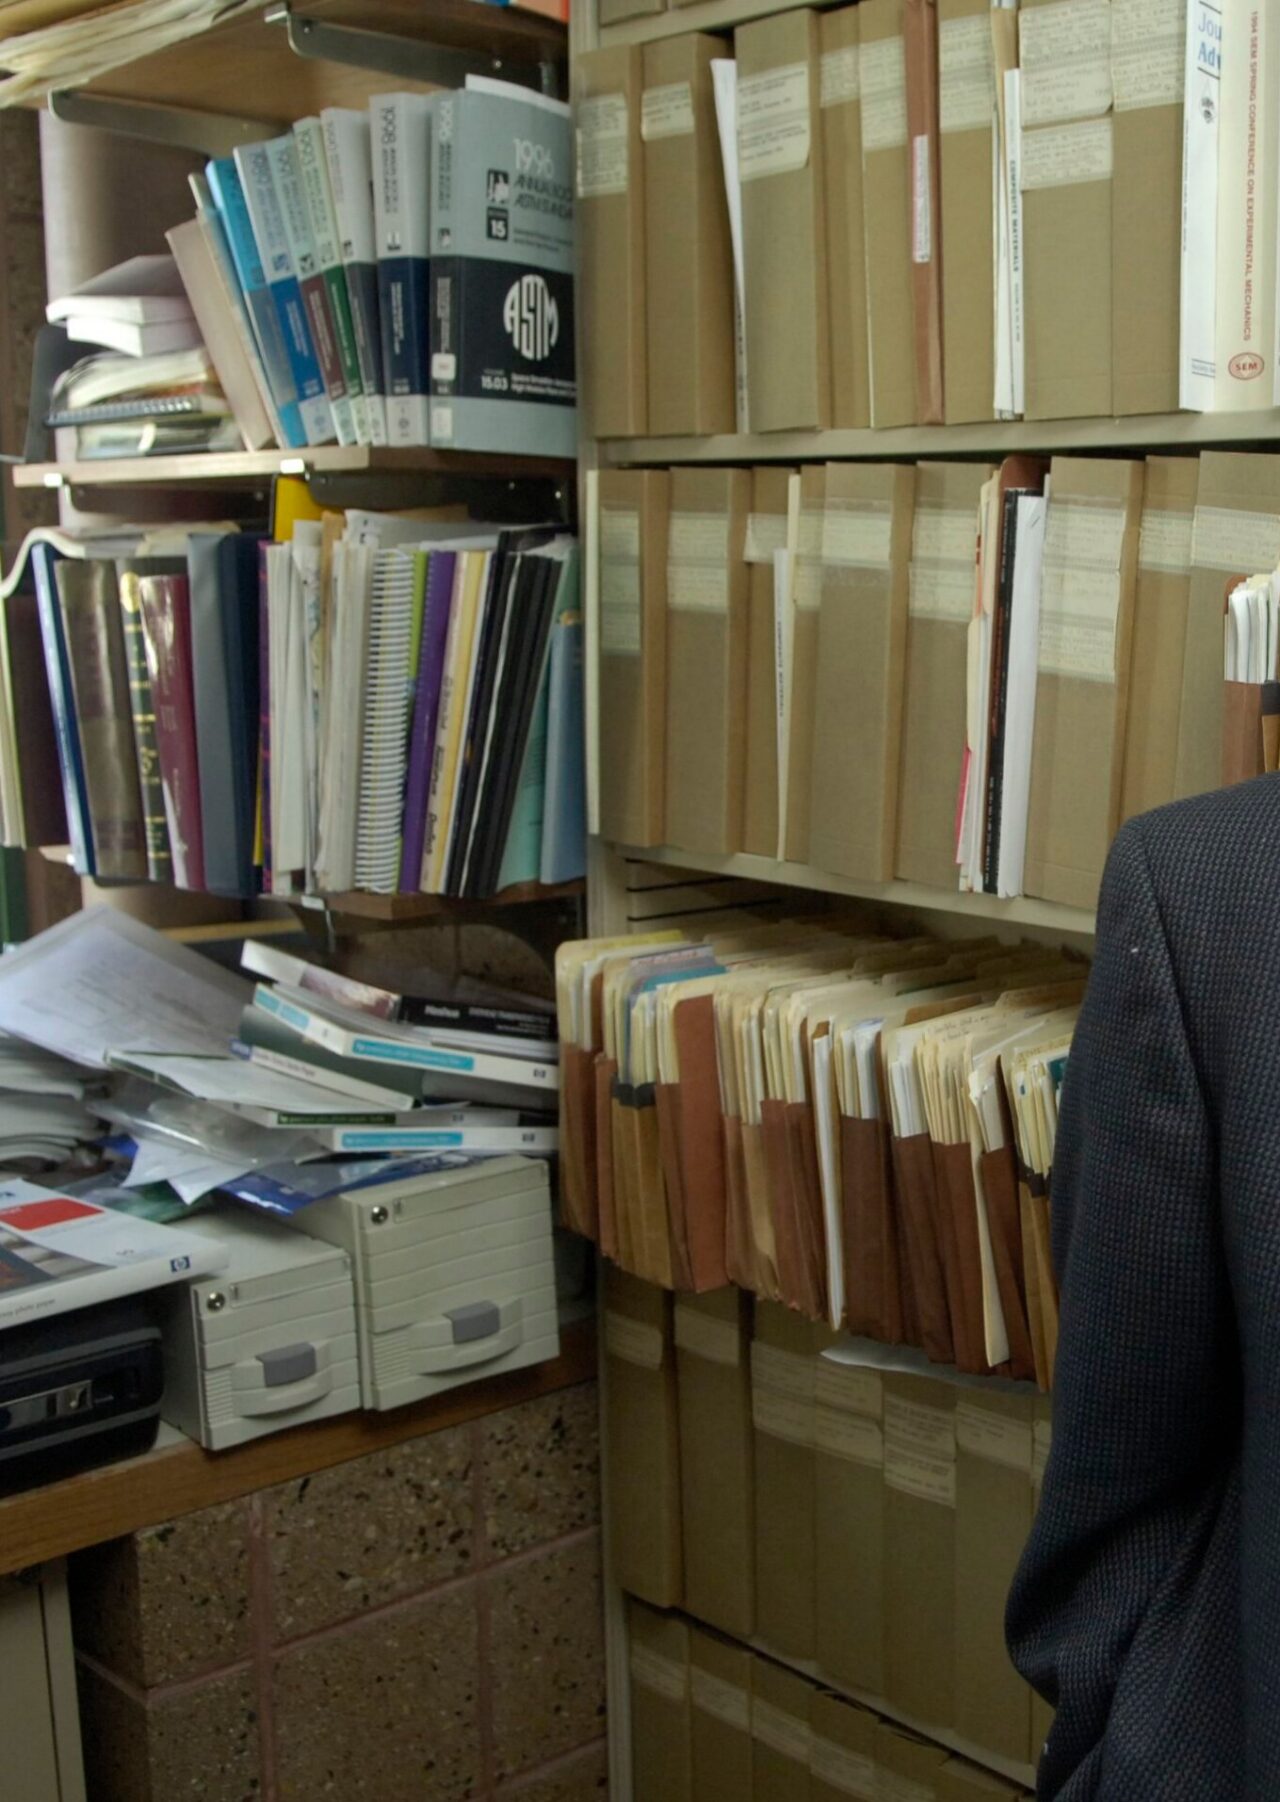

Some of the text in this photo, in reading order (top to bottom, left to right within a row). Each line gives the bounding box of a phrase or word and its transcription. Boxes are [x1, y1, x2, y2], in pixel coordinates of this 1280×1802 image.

[1250, 36, 1258, 59] SEM
[1249, 61, 1257, 101] SPRING
[512, 137, 555, 180] 1996
[1247, 103, 1257, 176] CONFERENCE
[1247, 179, 1255, 195] ON
[490, 219, 506, 238] 15
[1244, 197, 1254, 276] EXPERIMENTAL
[503, 274, 559, 361] ASTM
[1243, 280, 1252, 341] MECHANICS
[1235, 362, 1258, 371] SEM
